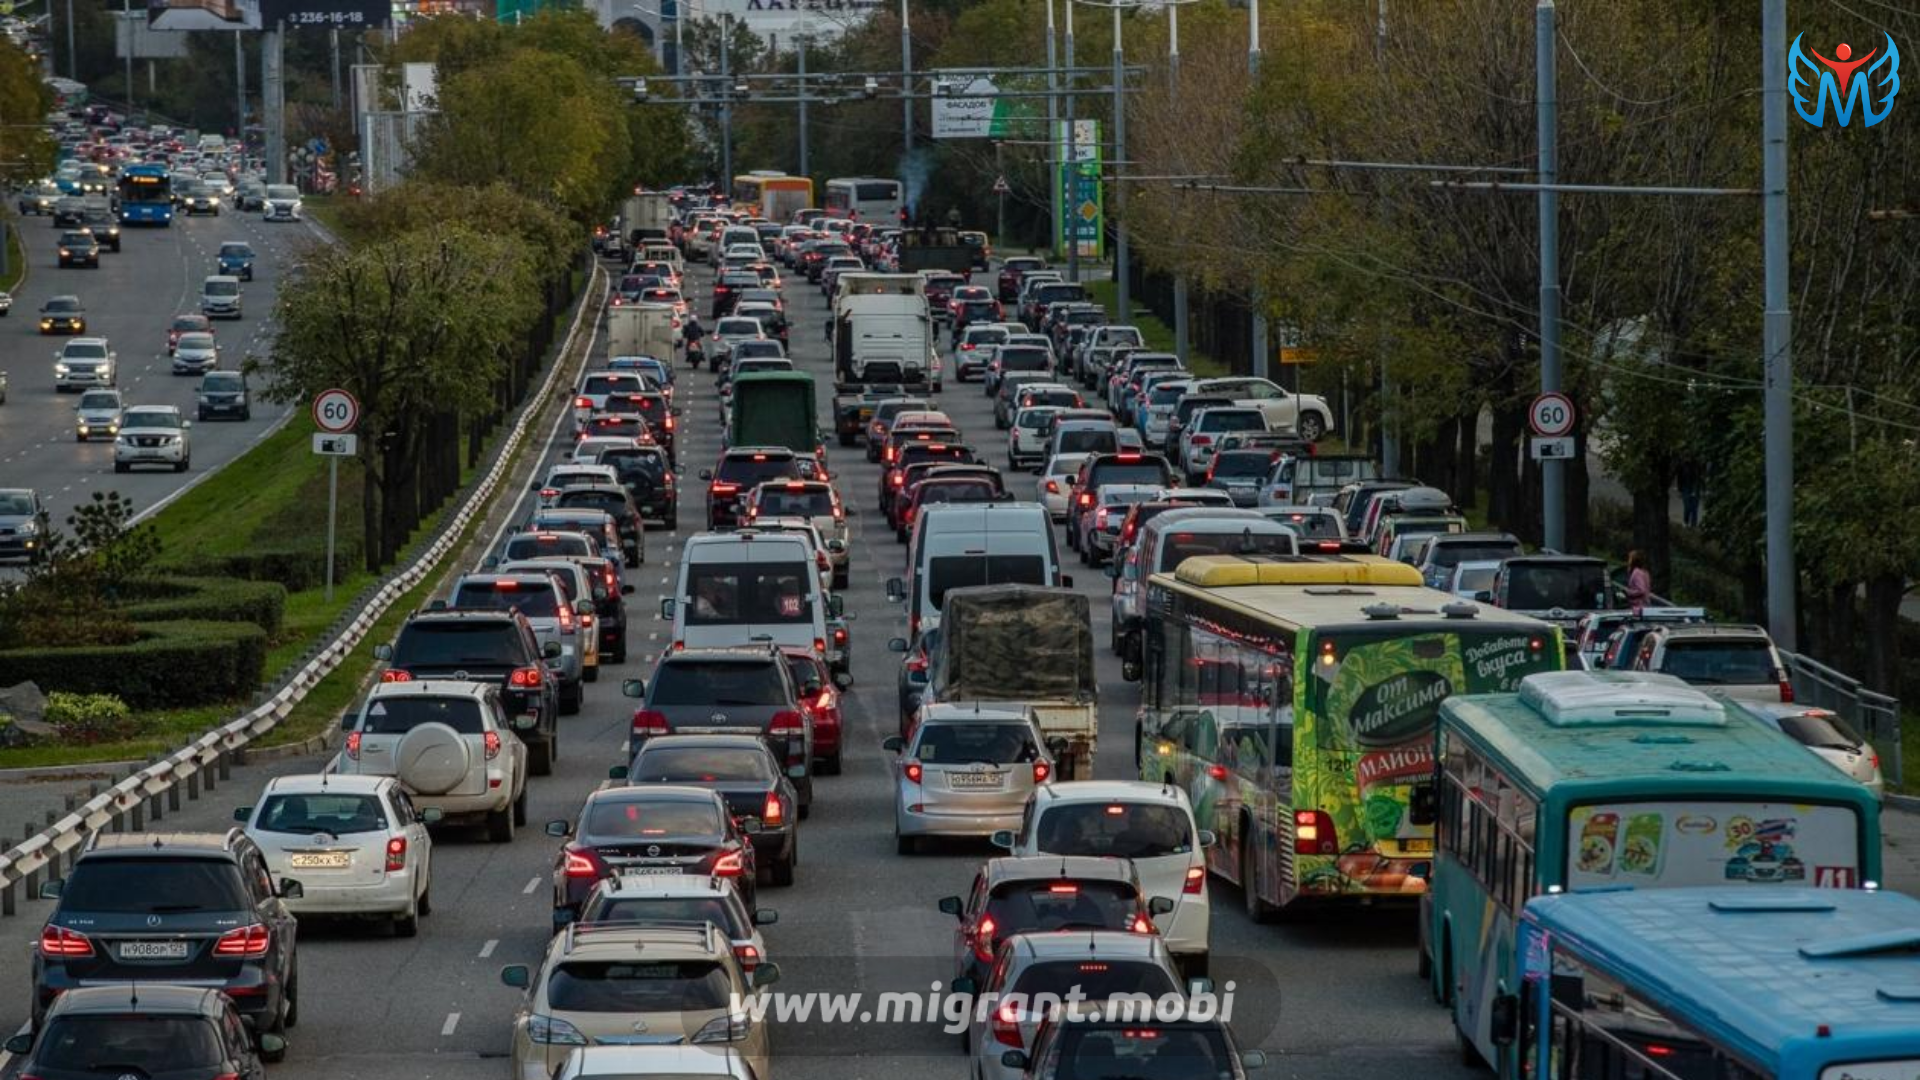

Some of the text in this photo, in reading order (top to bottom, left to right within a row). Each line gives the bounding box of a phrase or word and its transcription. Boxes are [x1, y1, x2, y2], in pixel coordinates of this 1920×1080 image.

[300, 12, 364, 23] 236-16-18
[324, 402, 348, 420] 60
[1541, 407, 1564, 424] 60
[1466, 636, 1529, 664] Добавьте
[1477, 650, 1527, 678] вкуса
[1326, 758, 1352, 772] 120
[1731, 822, 1751, 838] 30
[1820, 868, 1848, 888] 41
